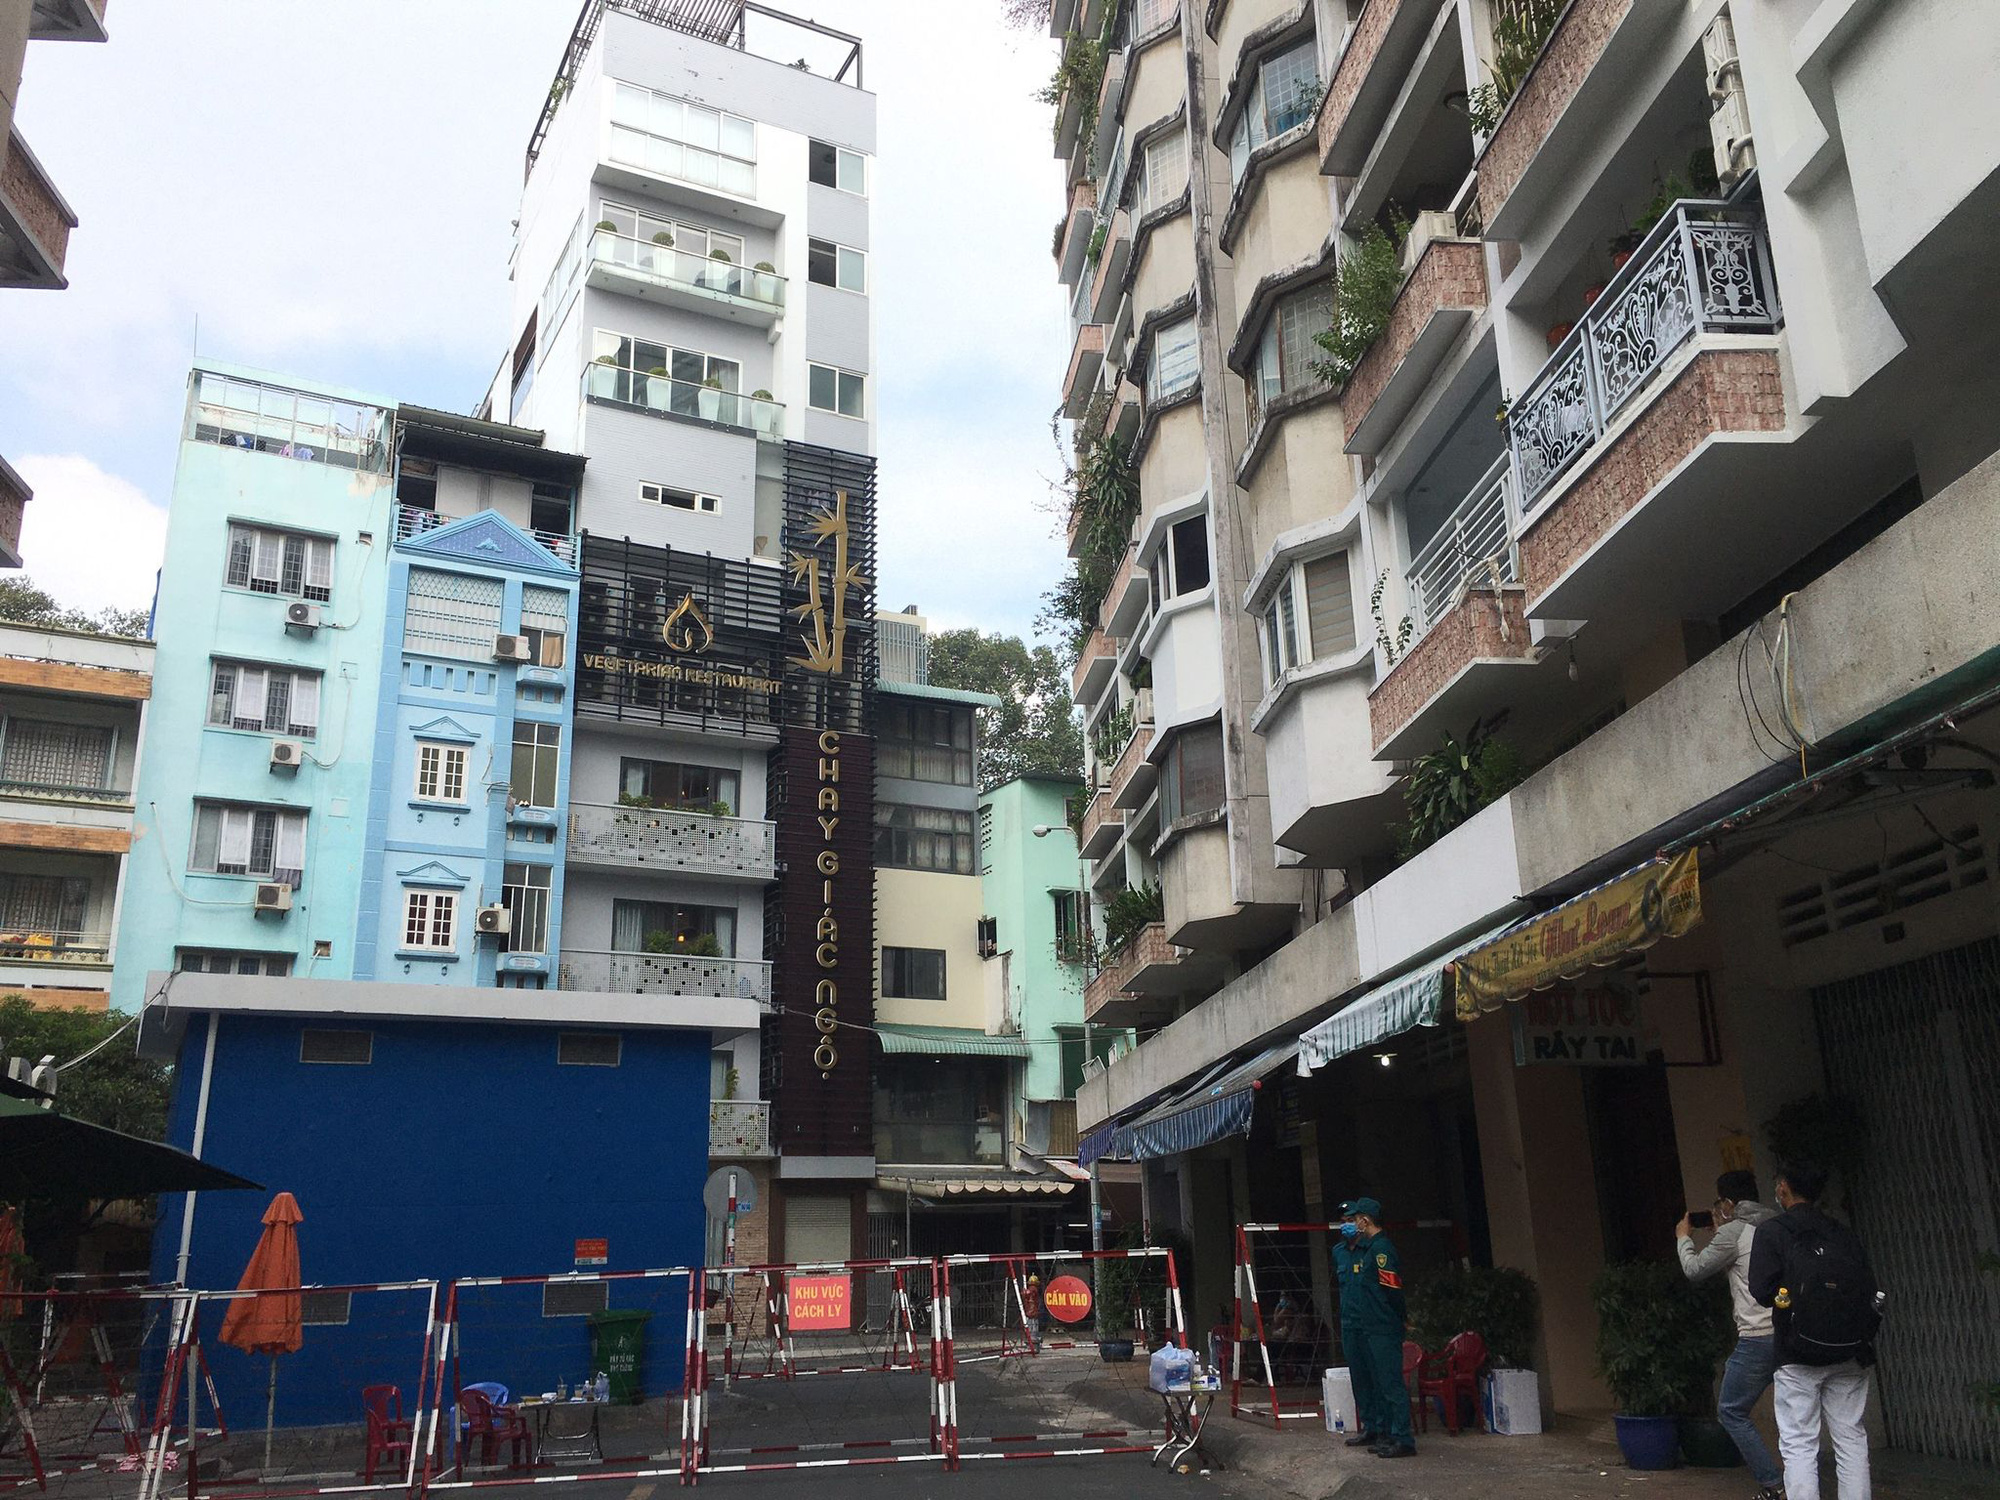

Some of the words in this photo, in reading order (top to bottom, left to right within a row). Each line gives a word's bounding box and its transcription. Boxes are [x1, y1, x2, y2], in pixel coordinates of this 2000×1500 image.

[583, 653, 682, 680] VEGETARIAN
[685, 667, 783, 695] RESTAURANT
[818, 730, 841, 842] CHAY
[816, 849, 841, 969] GIÁC
[814, 977, 840, 1081] NGỘ
[1594, 1036, 1637, 1059] TAI
[795, 1286, 818, 1300] KHU
[821, 1284, 844, 1301] VỰC
[1046, 1288, 1067, 1306] CẤM
[1068, 1290, 1088, 1306] VÀO
[794, 1302, 824, 1318] CÁCH
[827, 1304, 842, 1318] LY
